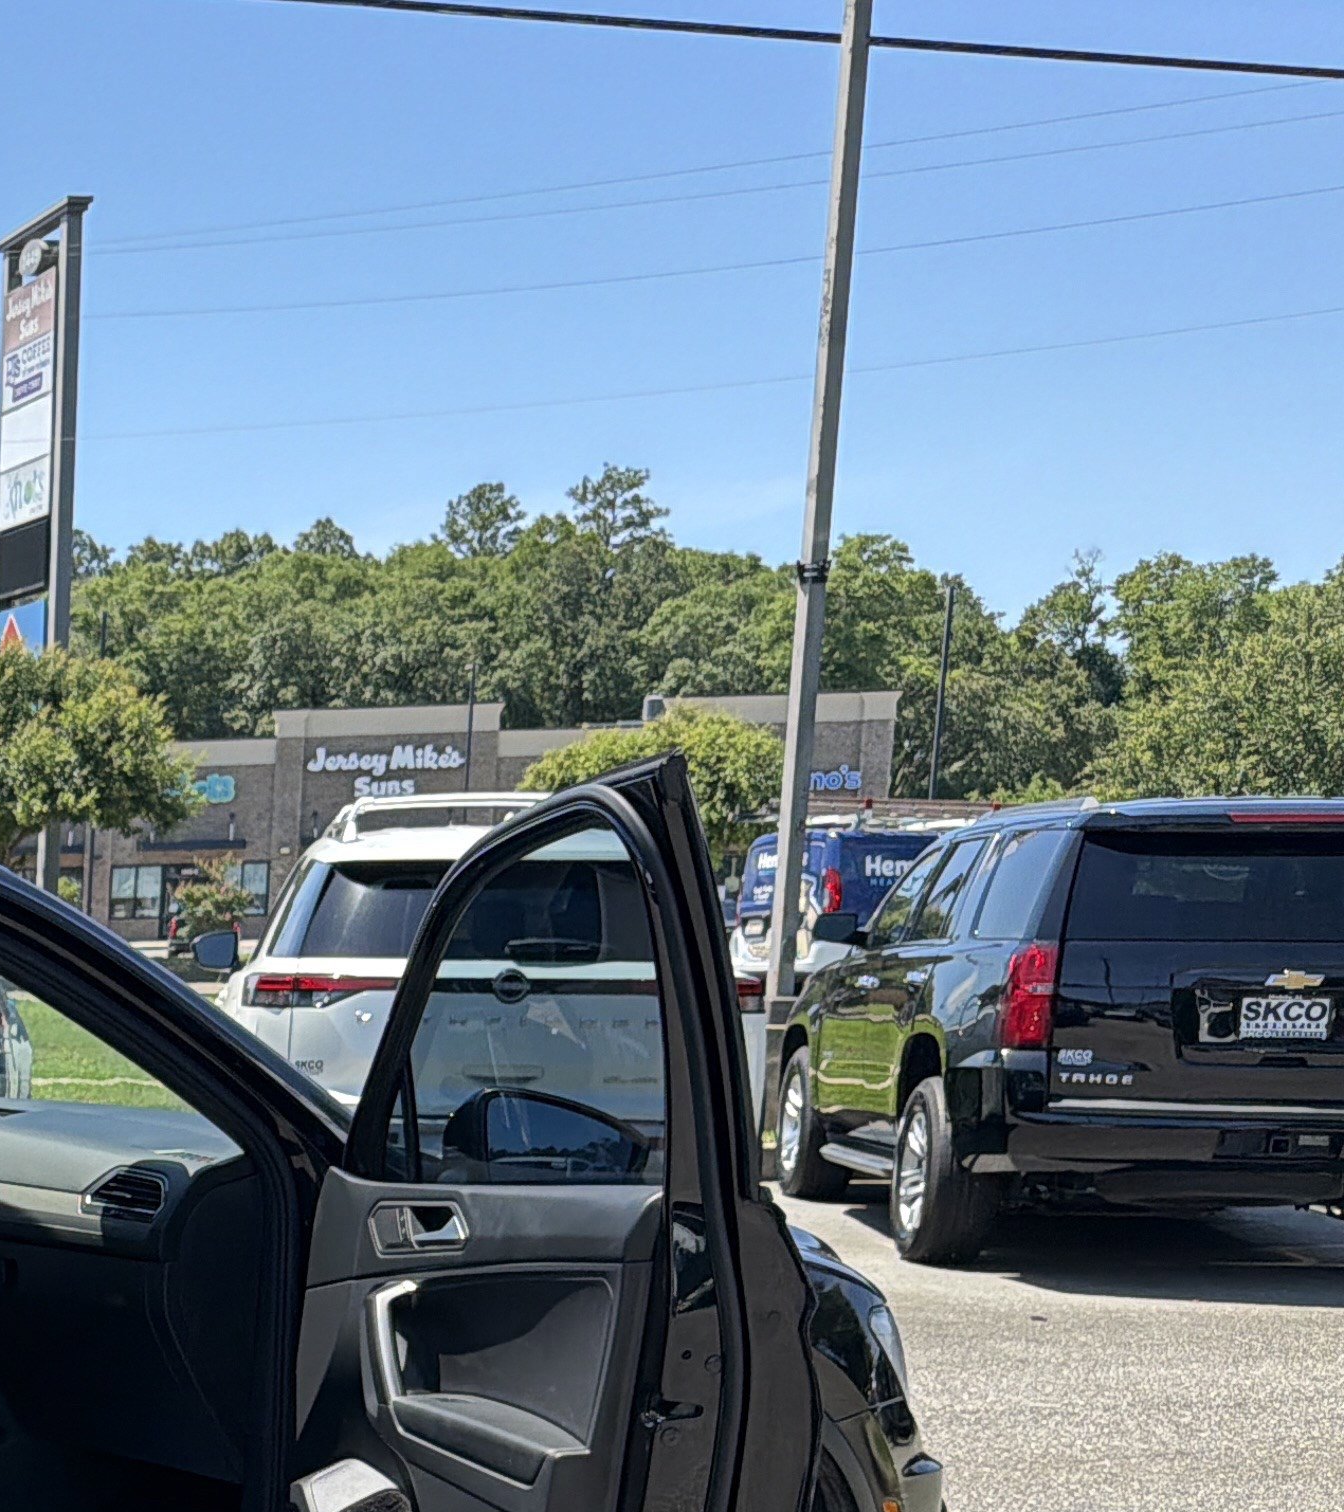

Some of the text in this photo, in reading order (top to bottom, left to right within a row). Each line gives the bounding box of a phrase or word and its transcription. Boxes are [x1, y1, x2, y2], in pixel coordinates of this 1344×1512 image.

[307, 744, 466, 776] Jersey Mike's
[1243, 1001, 1328, 1021] SKCO
[1059, 1073, 1133, 1085] TAHOE
